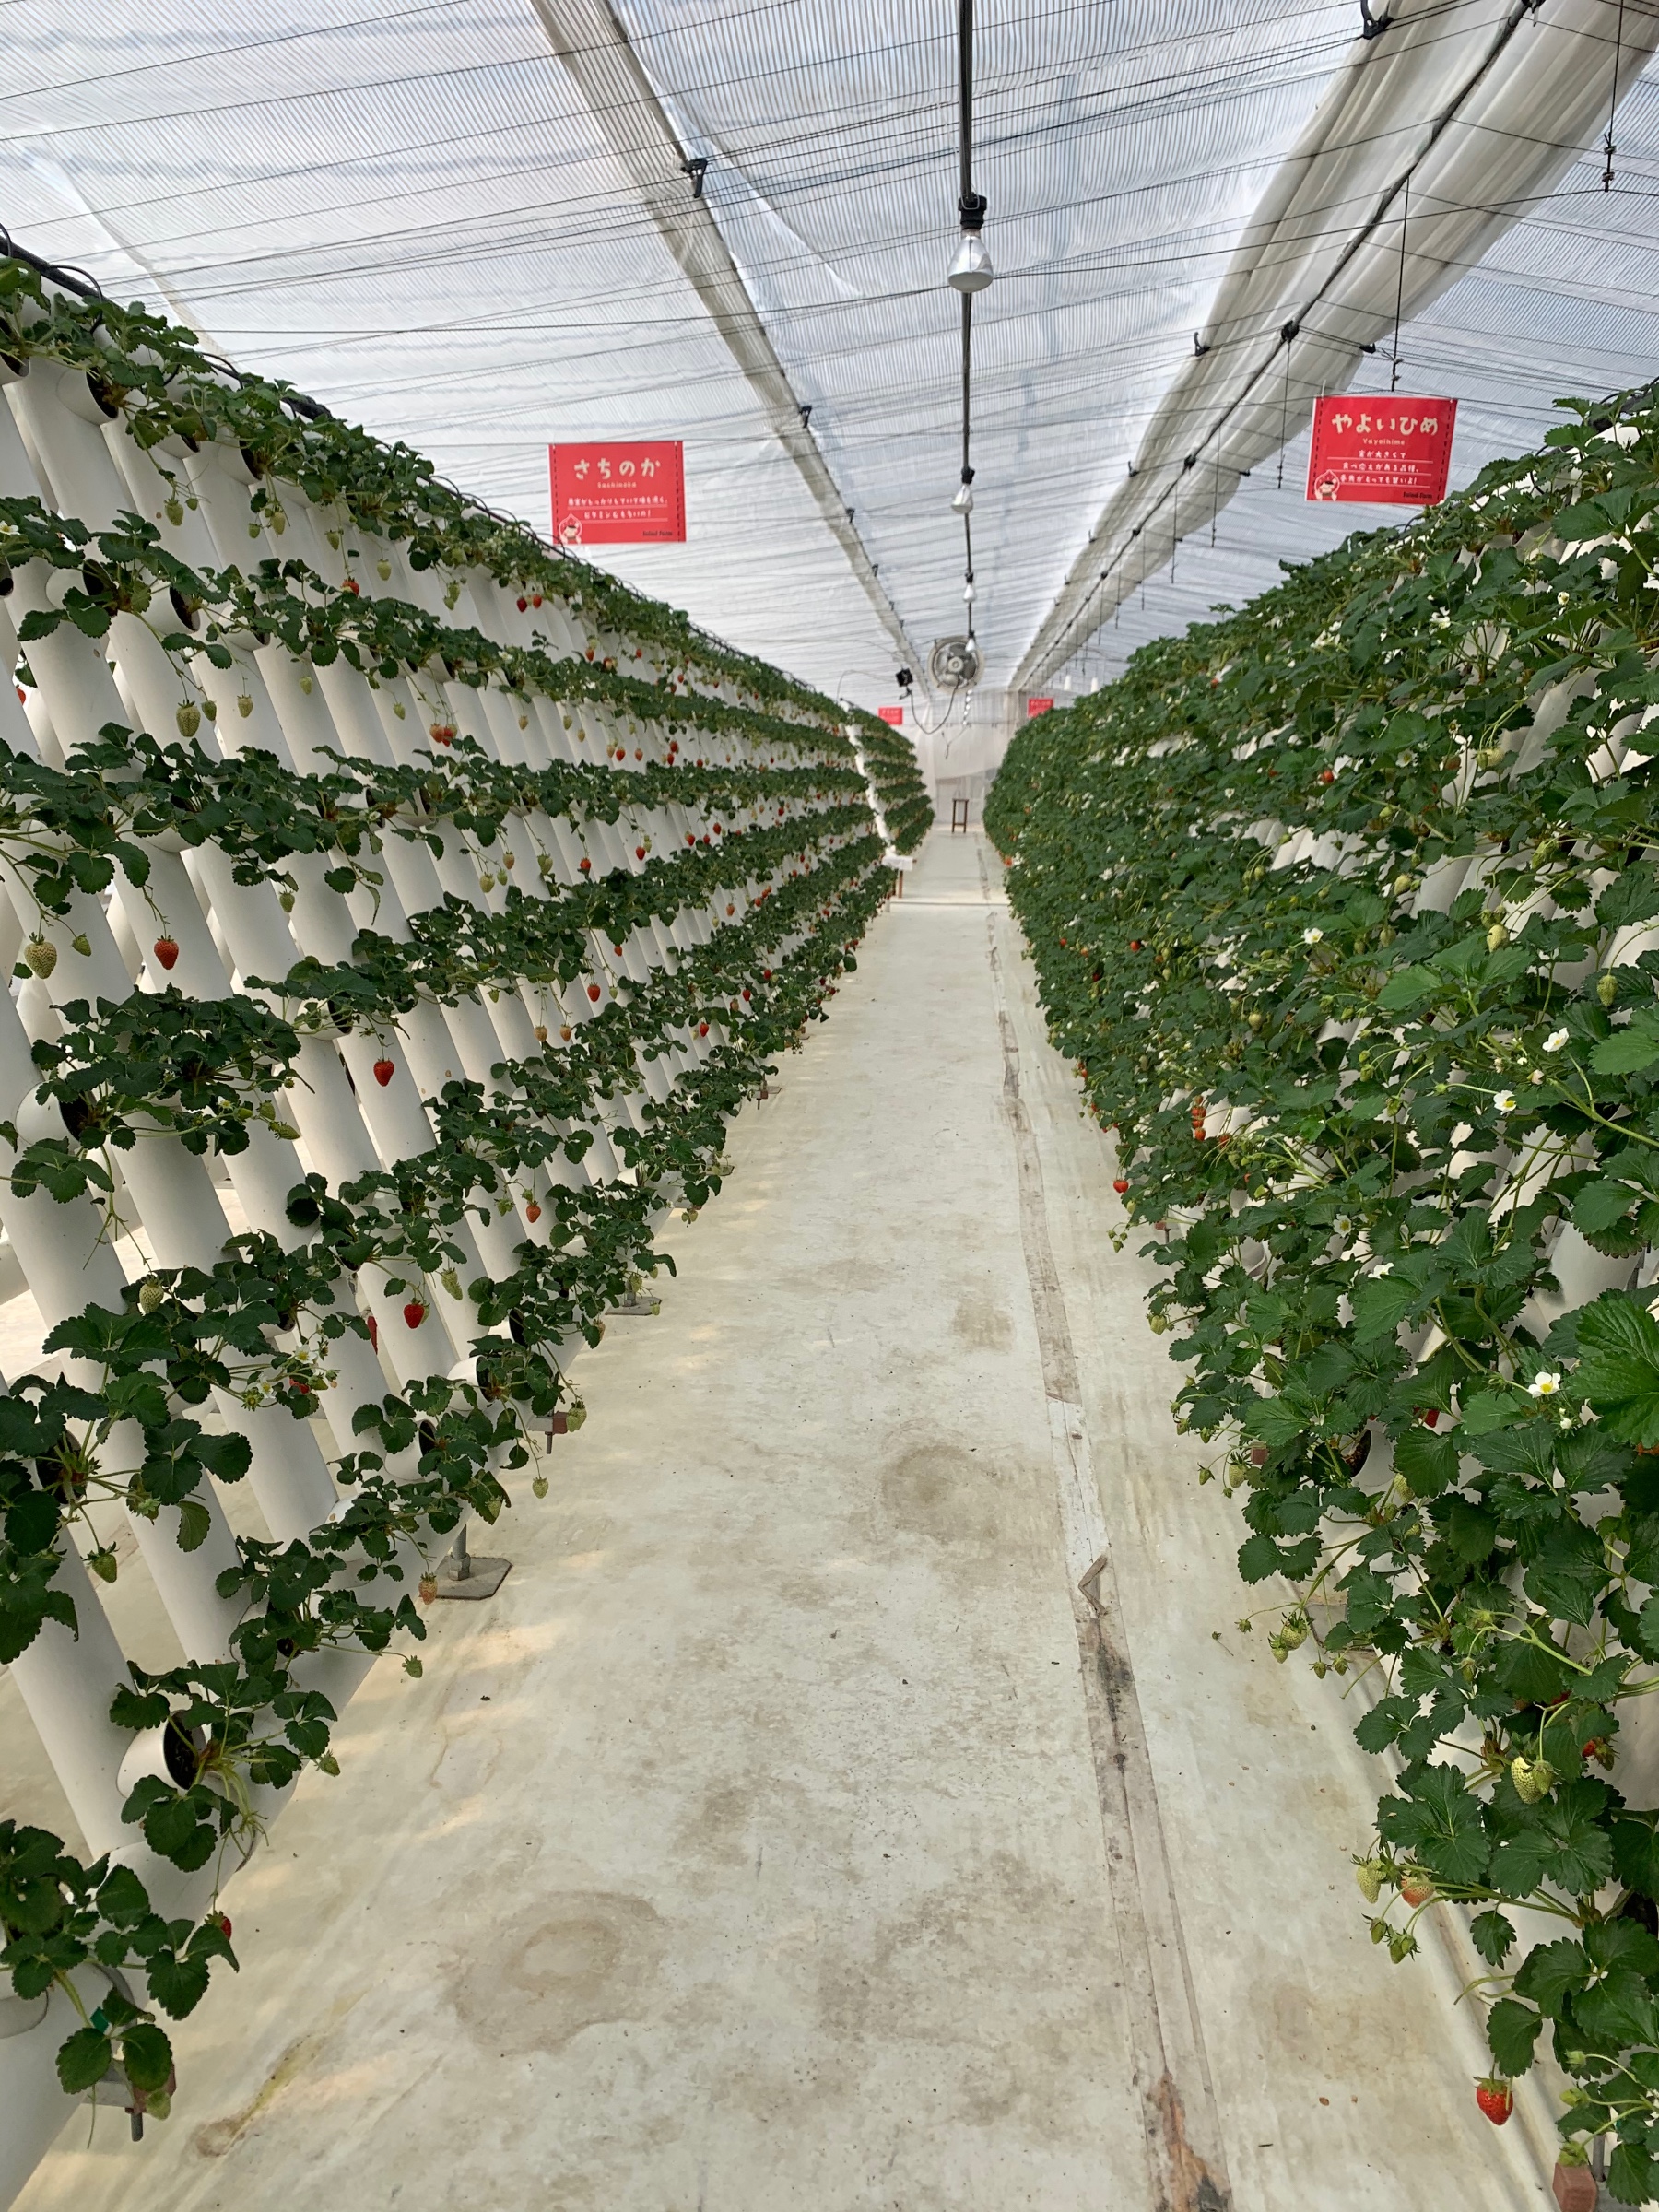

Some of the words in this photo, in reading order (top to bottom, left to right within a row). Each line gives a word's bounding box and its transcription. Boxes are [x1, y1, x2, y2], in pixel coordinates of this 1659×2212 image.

[1331, 413, 1439, 436] やよいひめ
[1362, 438, 1406, 446] Yayoihime
[573, 457, 661, 480] さちのか
